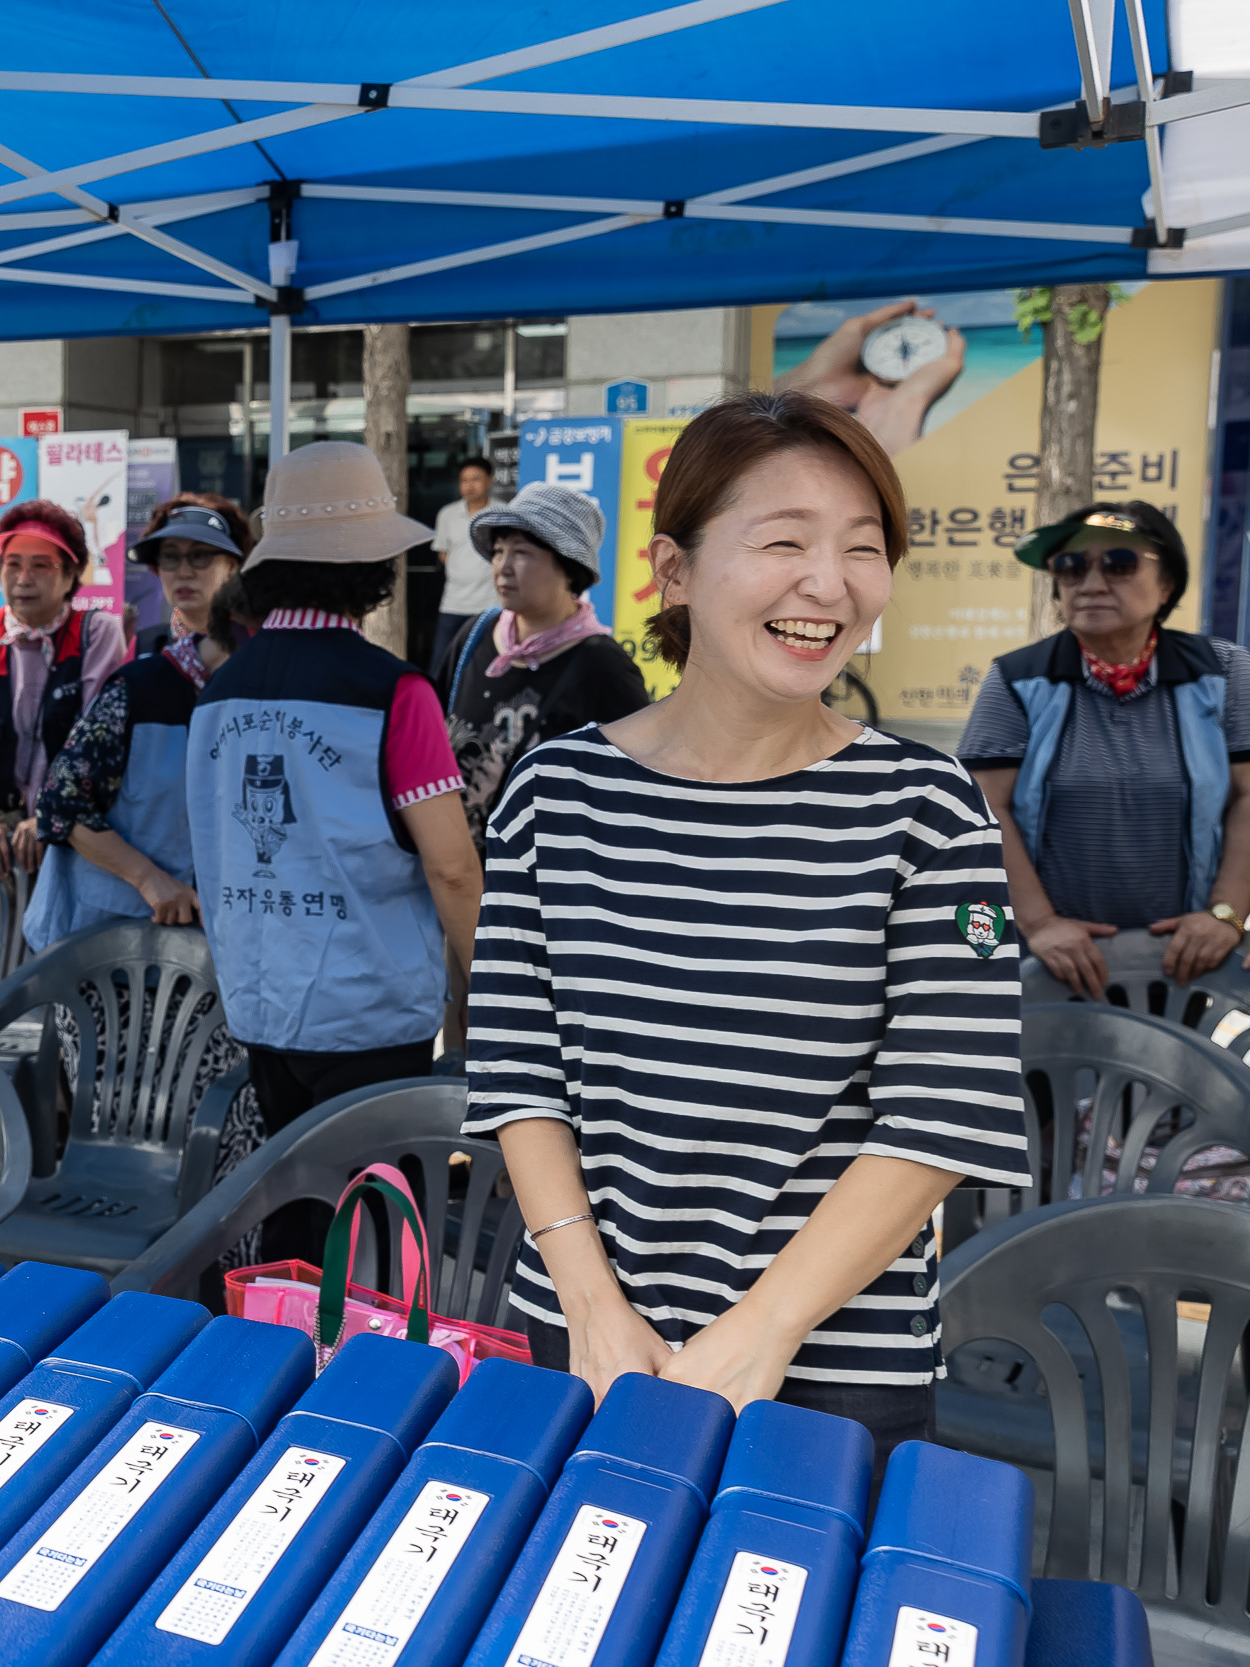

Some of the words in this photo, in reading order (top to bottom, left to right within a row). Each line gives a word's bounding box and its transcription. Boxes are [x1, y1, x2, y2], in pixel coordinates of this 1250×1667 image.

[108, 1445, 169, 1493] 태극기
[258, 1472, 315, 1522] 태극기
[402, 1508, 459, 1562] 태극기
[564, 1534, 618, 1592] 태극기
[732, 1584, 780, 1645] 태극기
